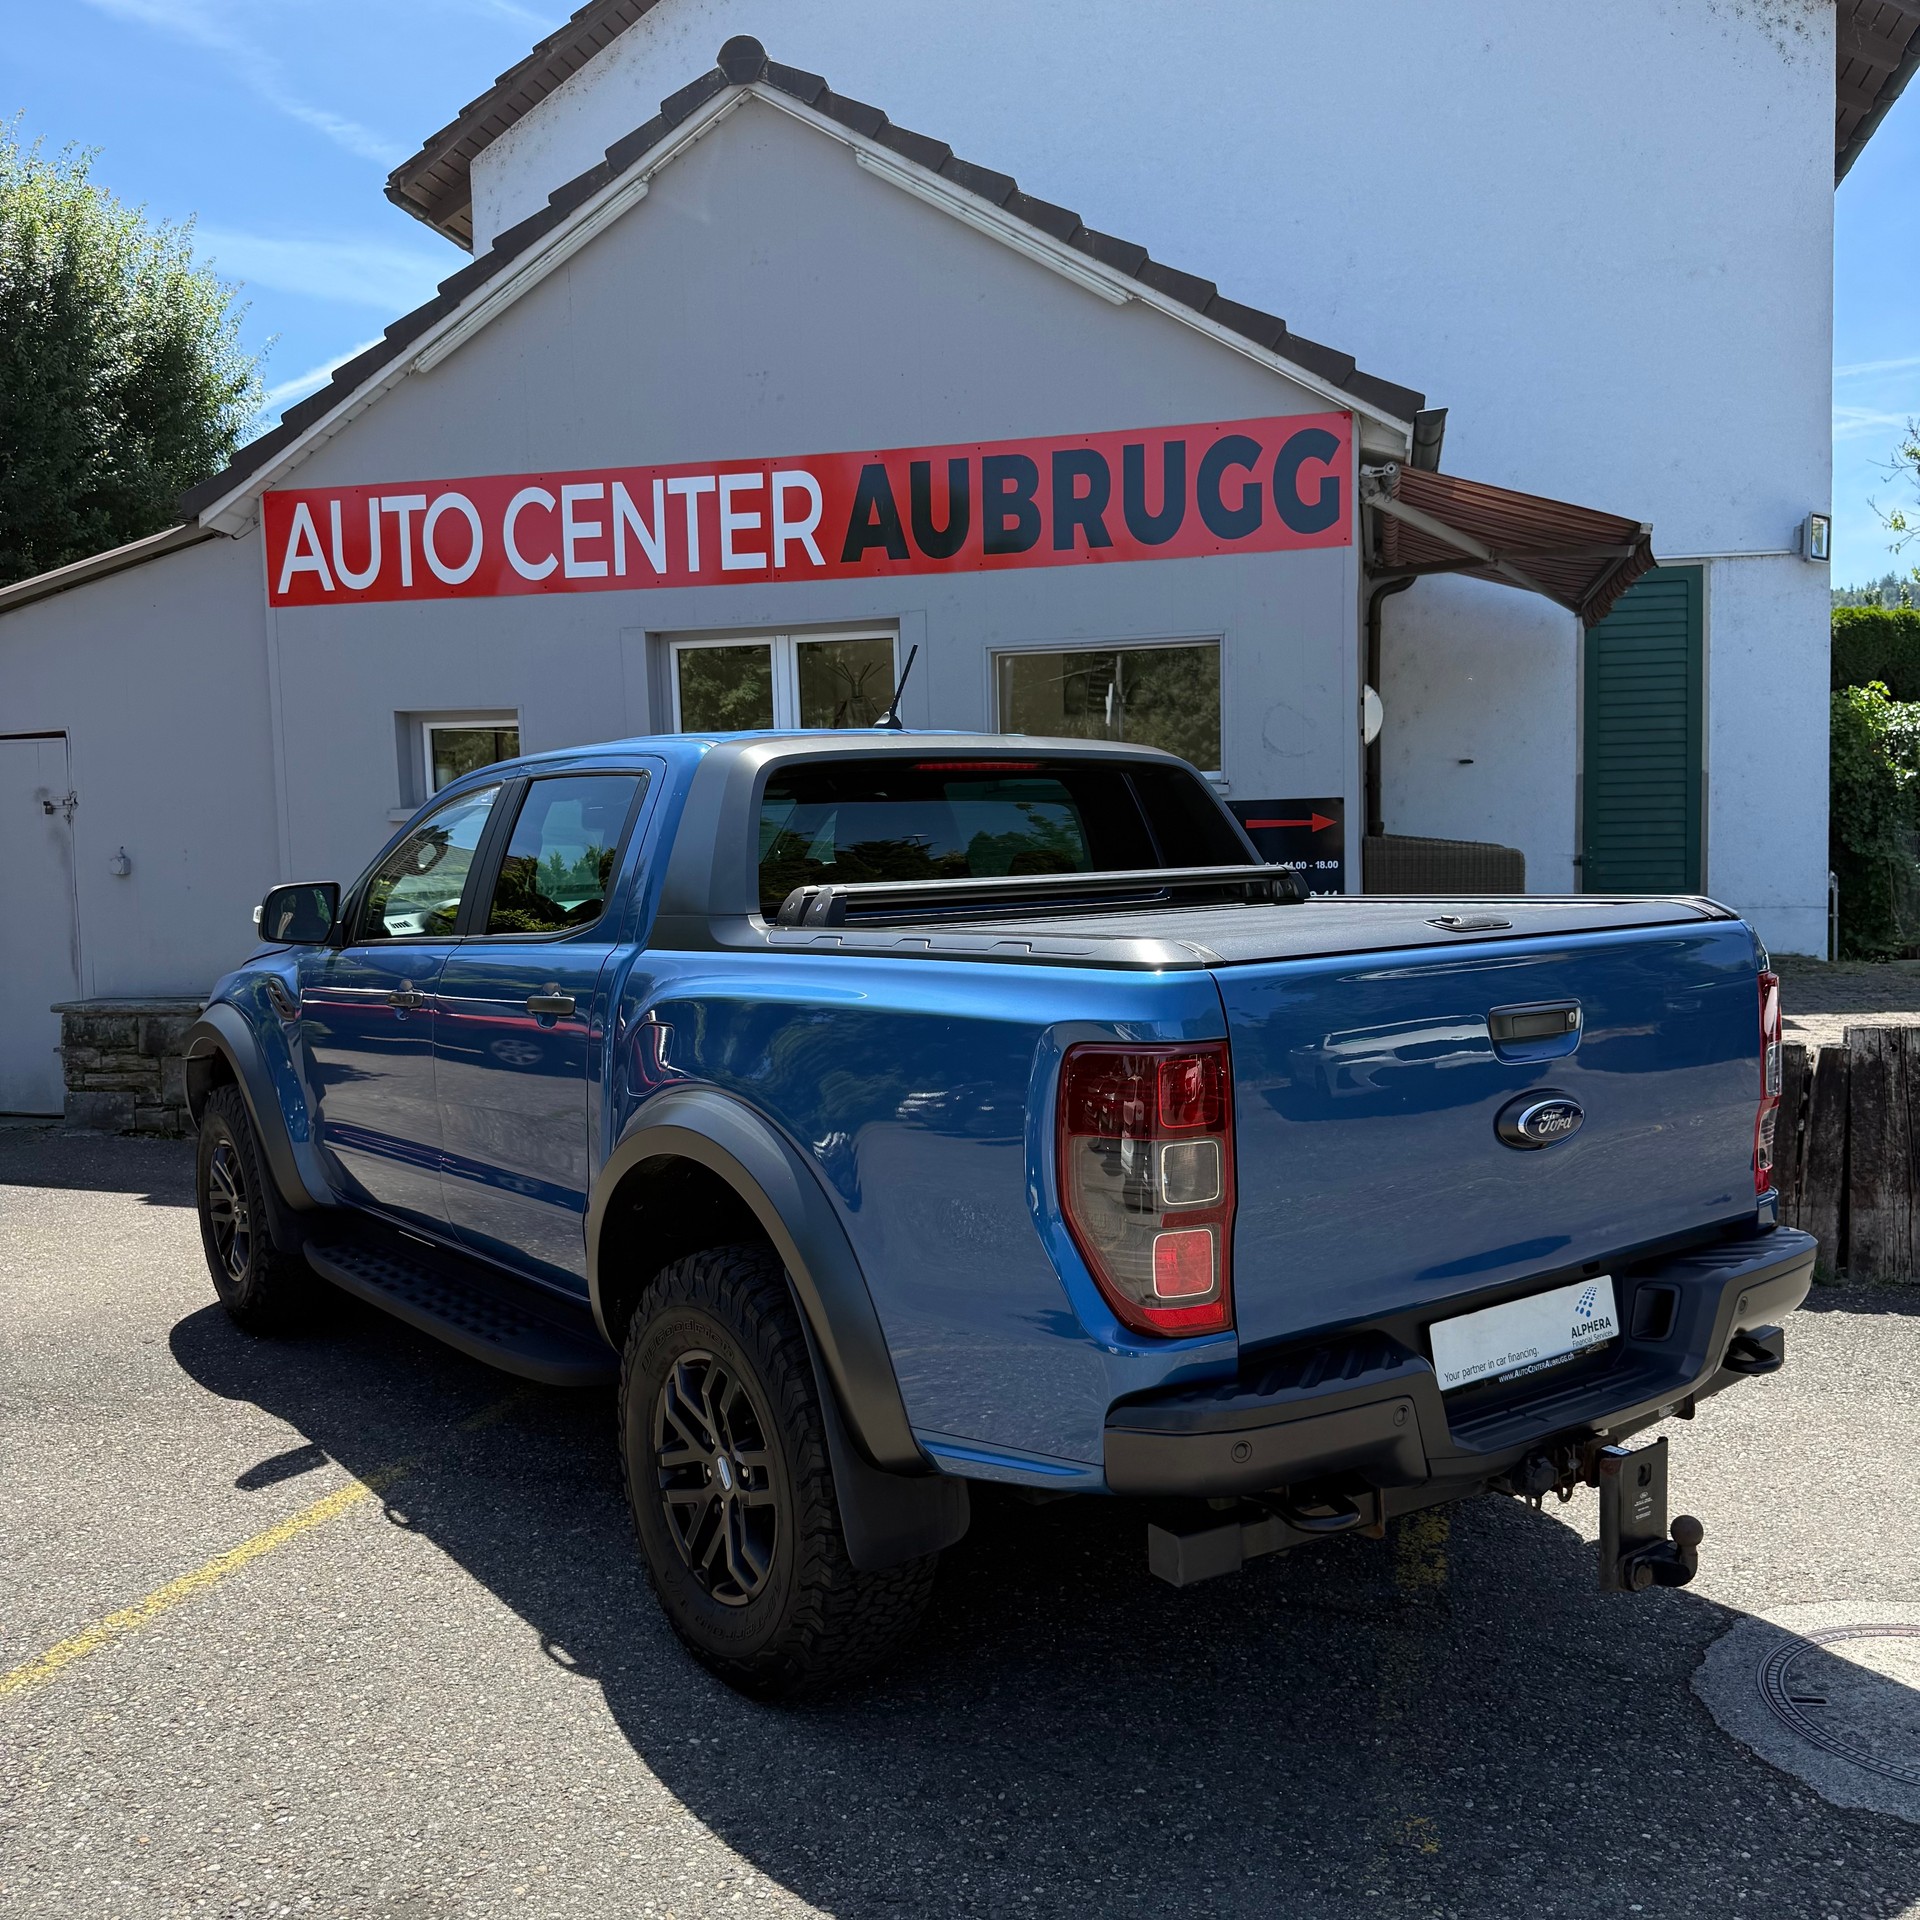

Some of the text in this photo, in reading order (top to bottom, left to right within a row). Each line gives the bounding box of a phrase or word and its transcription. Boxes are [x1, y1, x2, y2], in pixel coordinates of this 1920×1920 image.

[278, 428, 1342, 594] AUTO CENTER AUBRUGG
[1315, 860, 1339, 869] 18.00
[1534, 1107, 1574, 1134] Ford
[1571, 1316, 1612, 1339] ALPHERA
[1572, 1329, 1614, 1348] Financial Services
[1444, 1347, 1540, 1383] Your partner in car financing.
